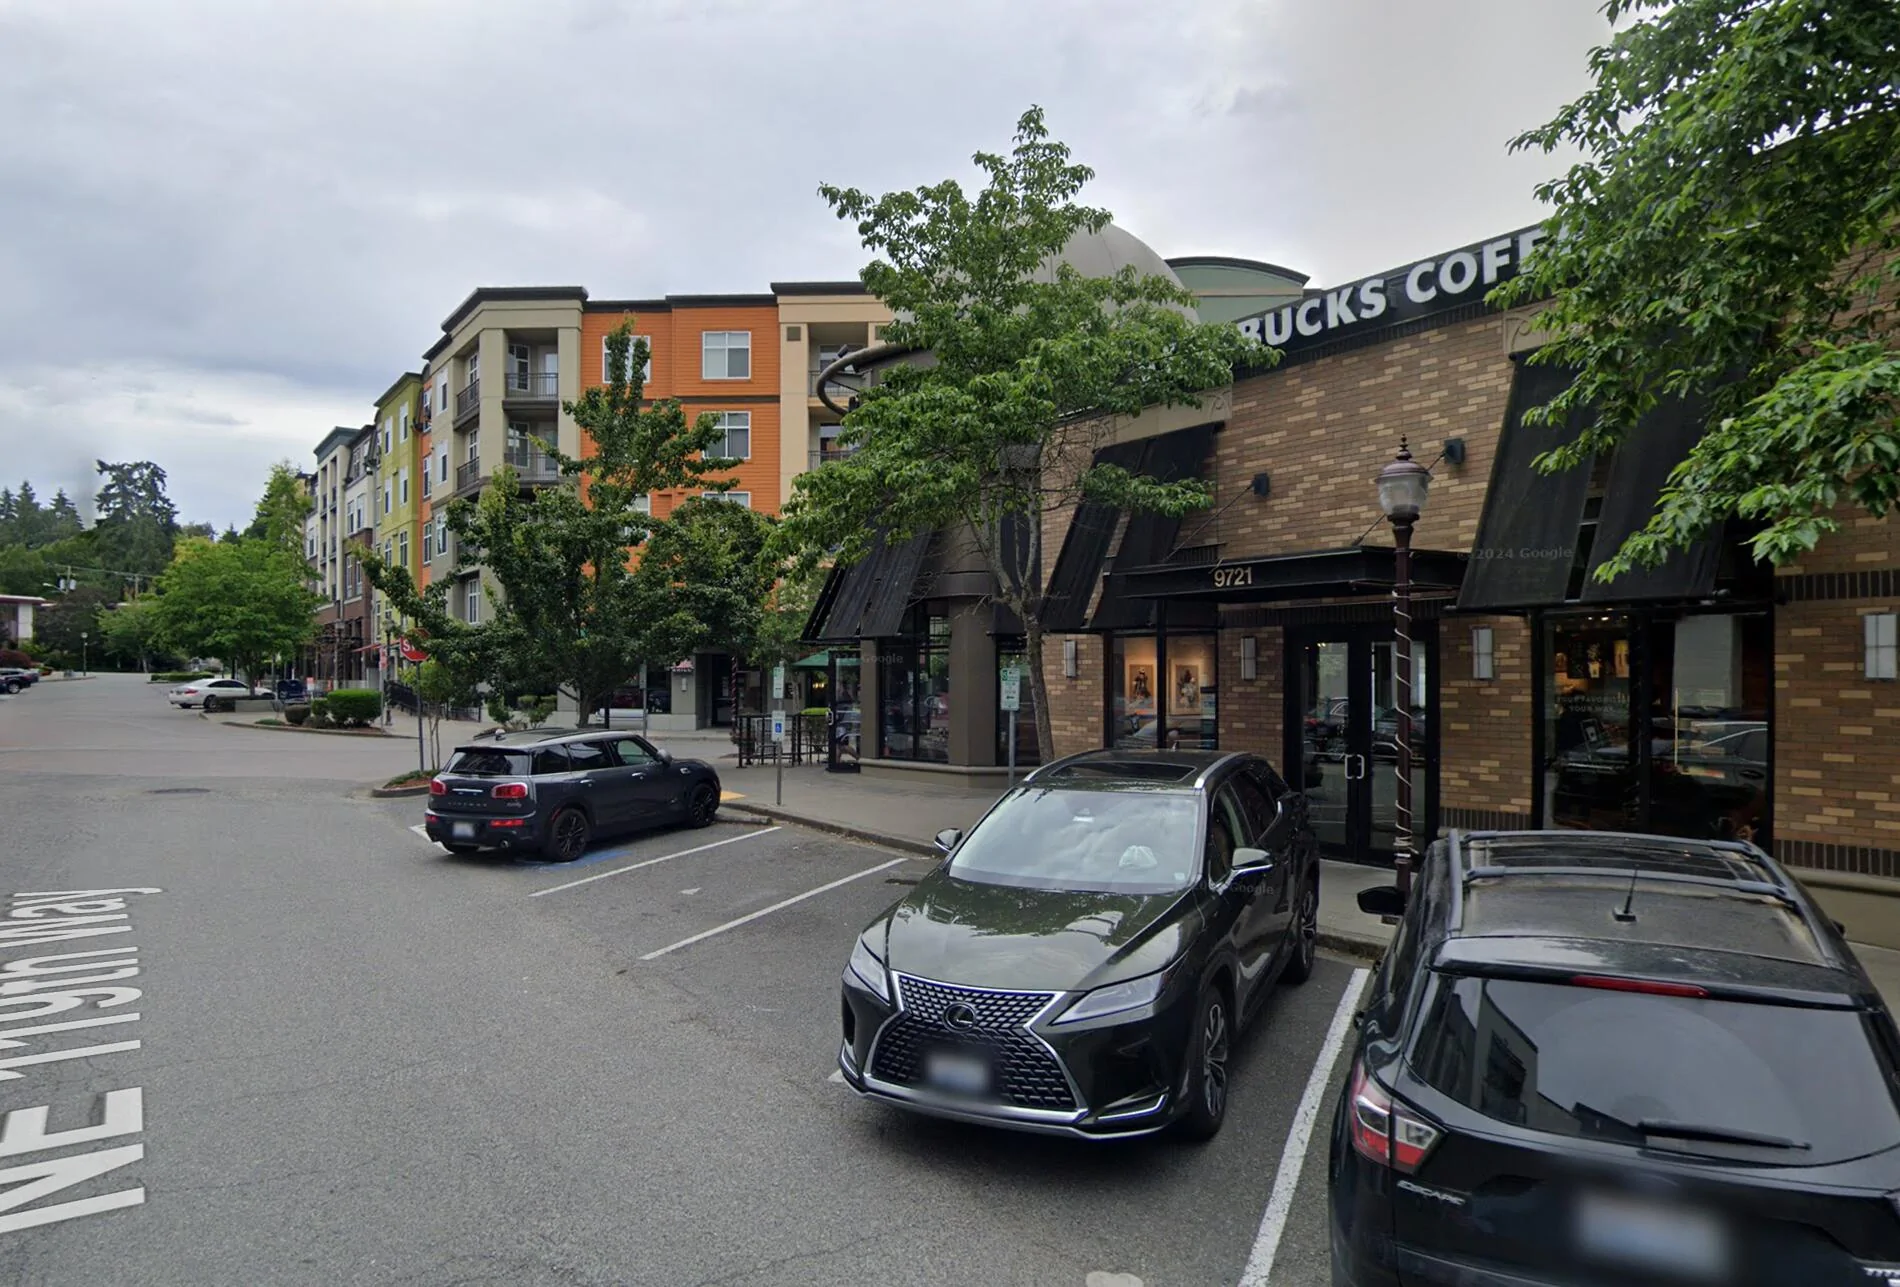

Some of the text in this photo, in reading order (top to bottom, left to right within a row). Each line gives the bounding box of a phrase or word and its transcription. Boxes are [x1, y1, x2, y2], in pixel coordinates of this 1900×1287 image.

[1214, 566, 1252, 588] 9721
[0, 887, 163, 948] Way
[0, 1086, 145, 1233] NE
